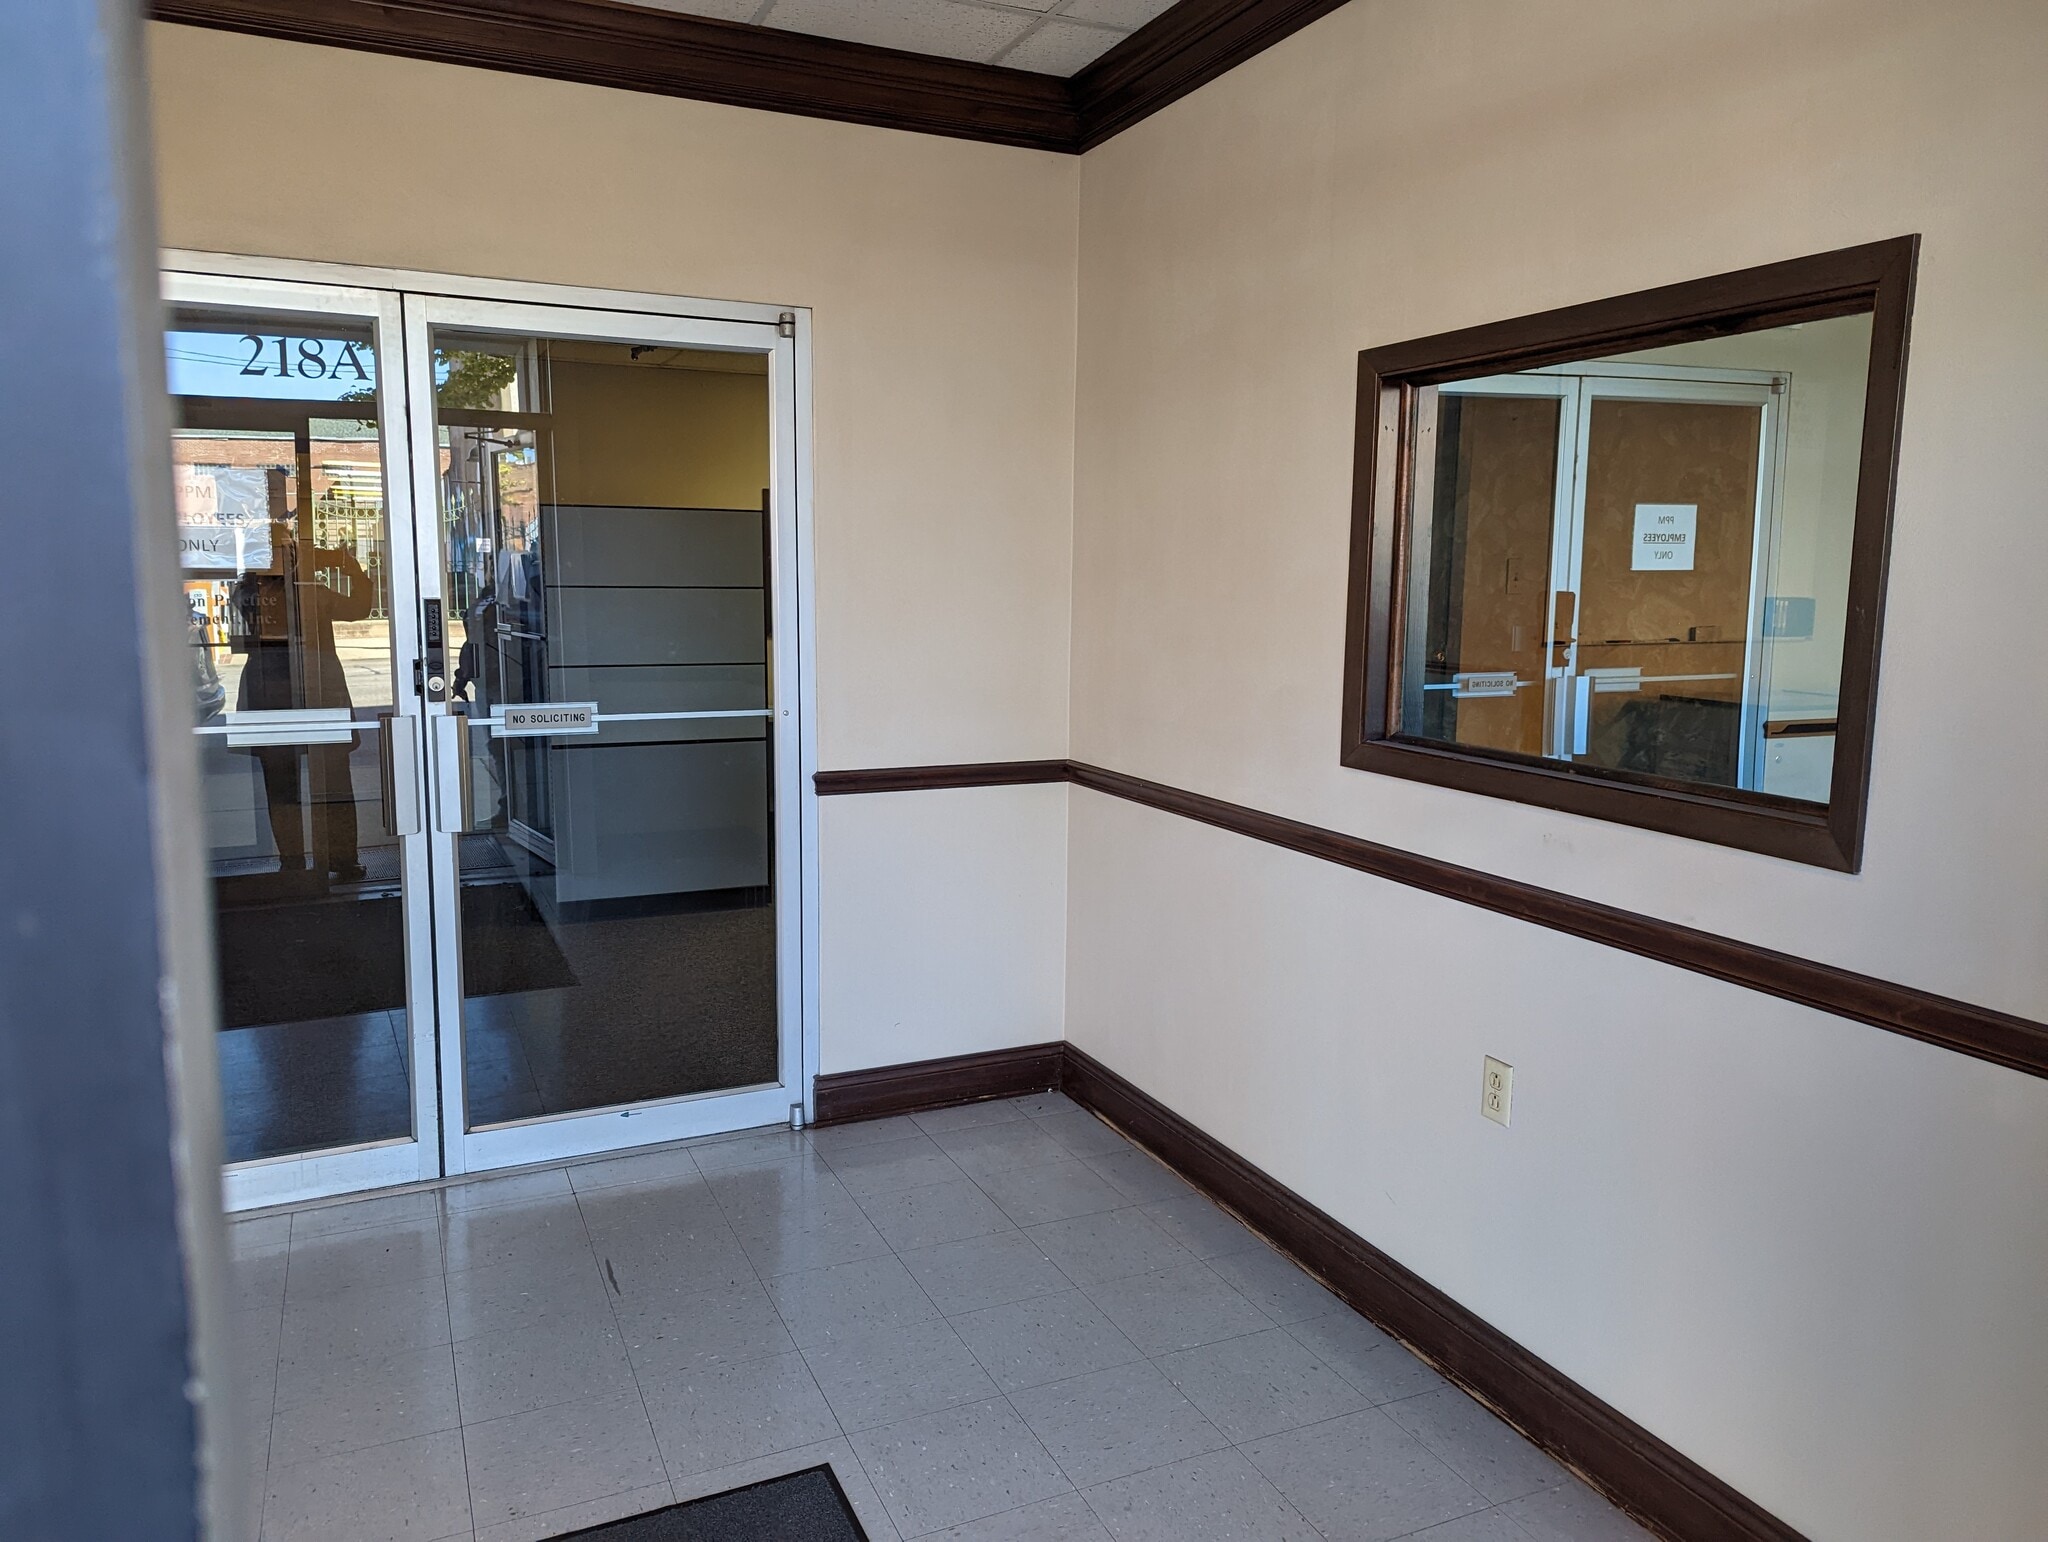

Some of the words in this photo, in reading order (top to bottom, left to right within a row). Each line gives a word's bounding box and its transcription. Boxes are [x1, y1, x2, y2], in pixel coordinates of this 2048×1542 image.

[239, 335, 373, 381] 218A
[512, 715, 526, 724] NO
[530, 713, 586, 724] SOLICITING
